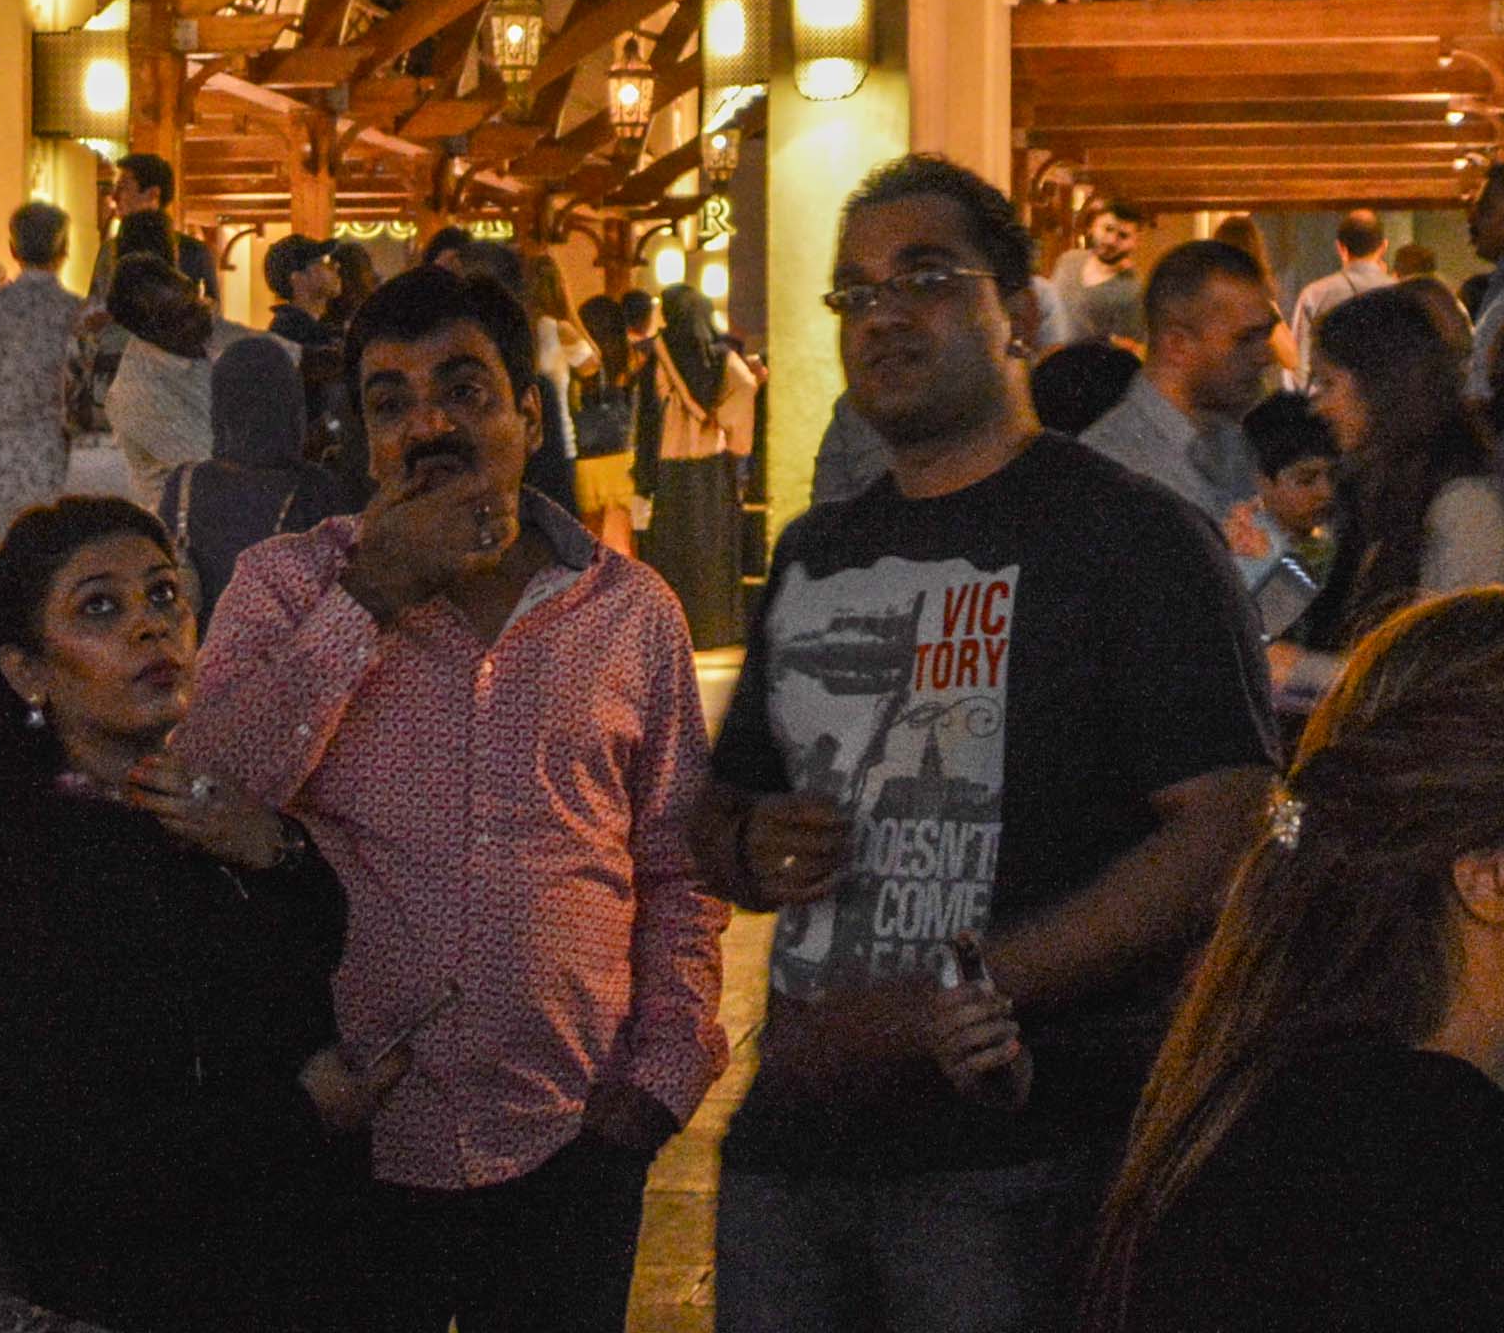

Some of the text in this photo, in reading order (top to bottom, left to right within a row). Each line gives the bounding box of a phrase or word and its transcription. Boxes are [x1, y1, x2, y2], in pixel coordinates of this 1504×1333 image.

[943, 581, 1009, 637] VIC
[915, 638, 1008, 691] TORY
[874, 880, 989, 939] COME
